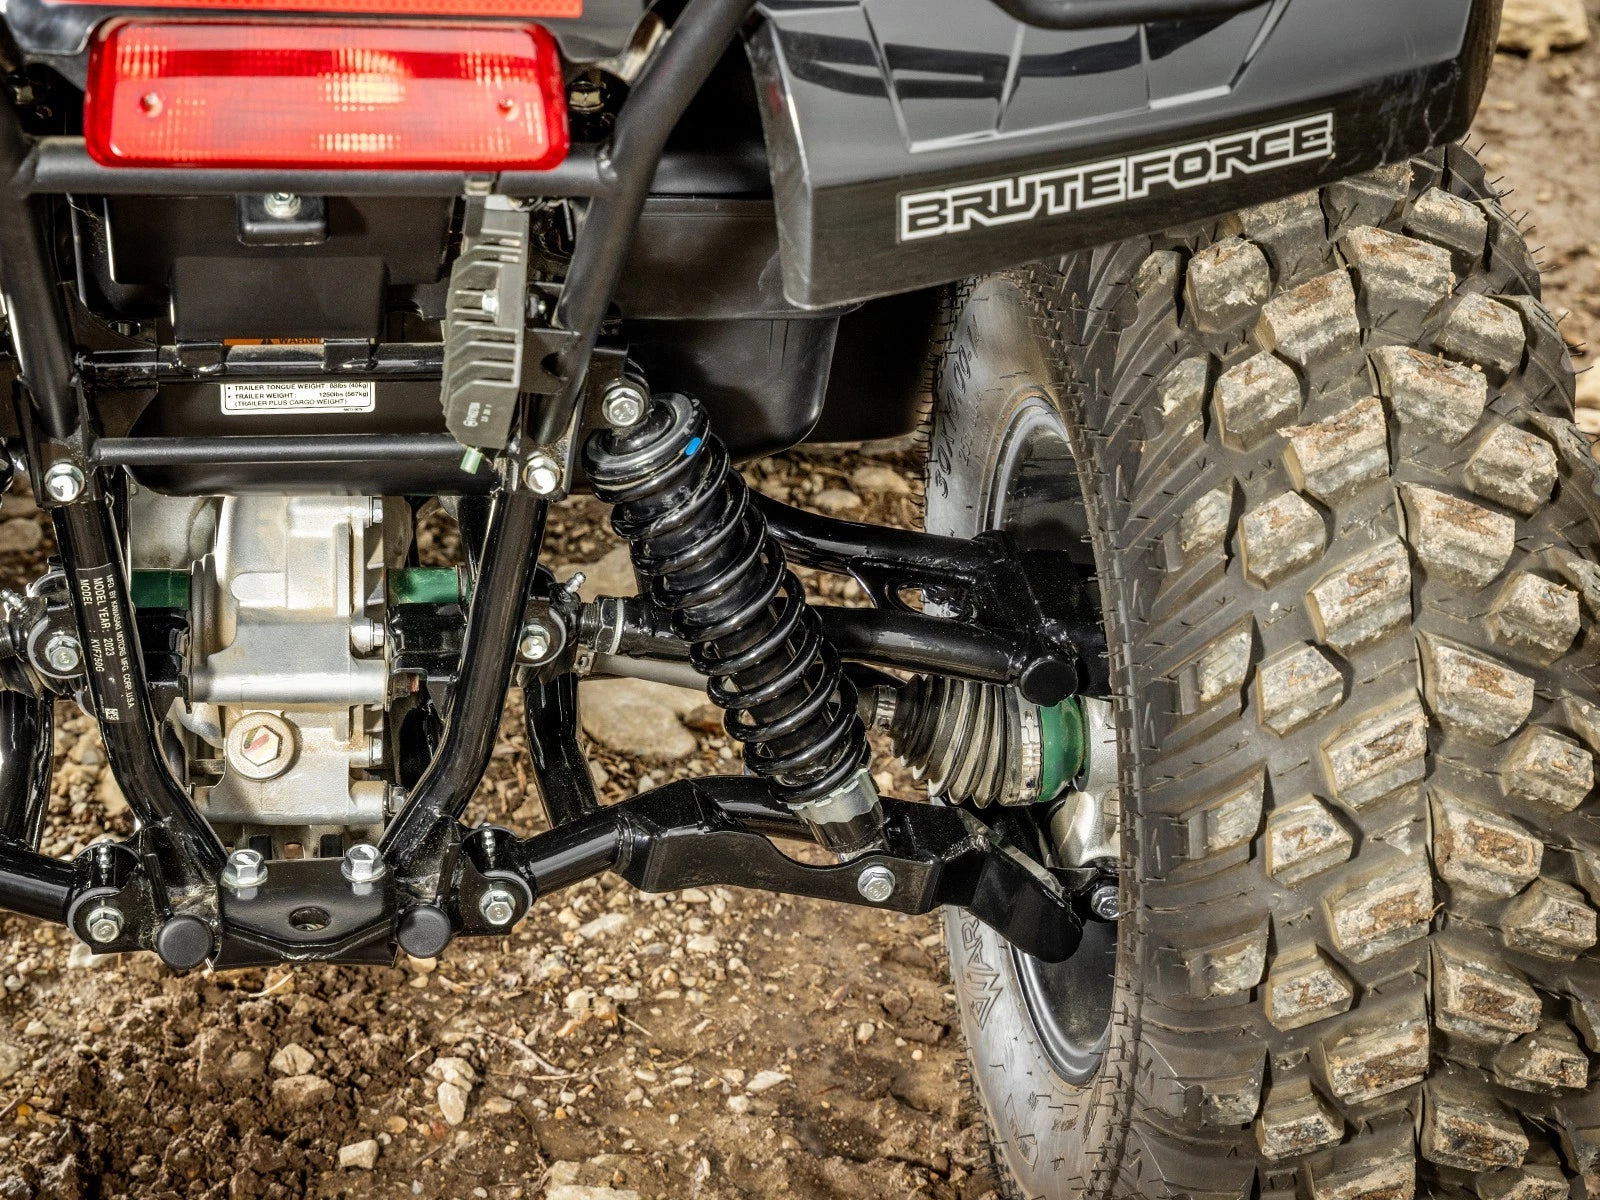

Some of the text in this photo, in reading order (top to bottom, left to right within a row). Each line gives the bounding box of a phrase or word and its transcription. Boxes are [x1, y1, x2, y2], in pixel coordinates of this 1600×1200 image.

[901, 112, 1334, 242] BRUTE FORCE
[93, 577, 105, 606] MODEL
[104, 638, 115, 656] 2023
[109, 591, 117, 600] BY
[111, 600, 122, 630] KAWASAKI
[80, 579, 93, 606] MODEL
[90, 639, 105, 672] KVF750G
[116, 631, 127, 656] MOTORS
